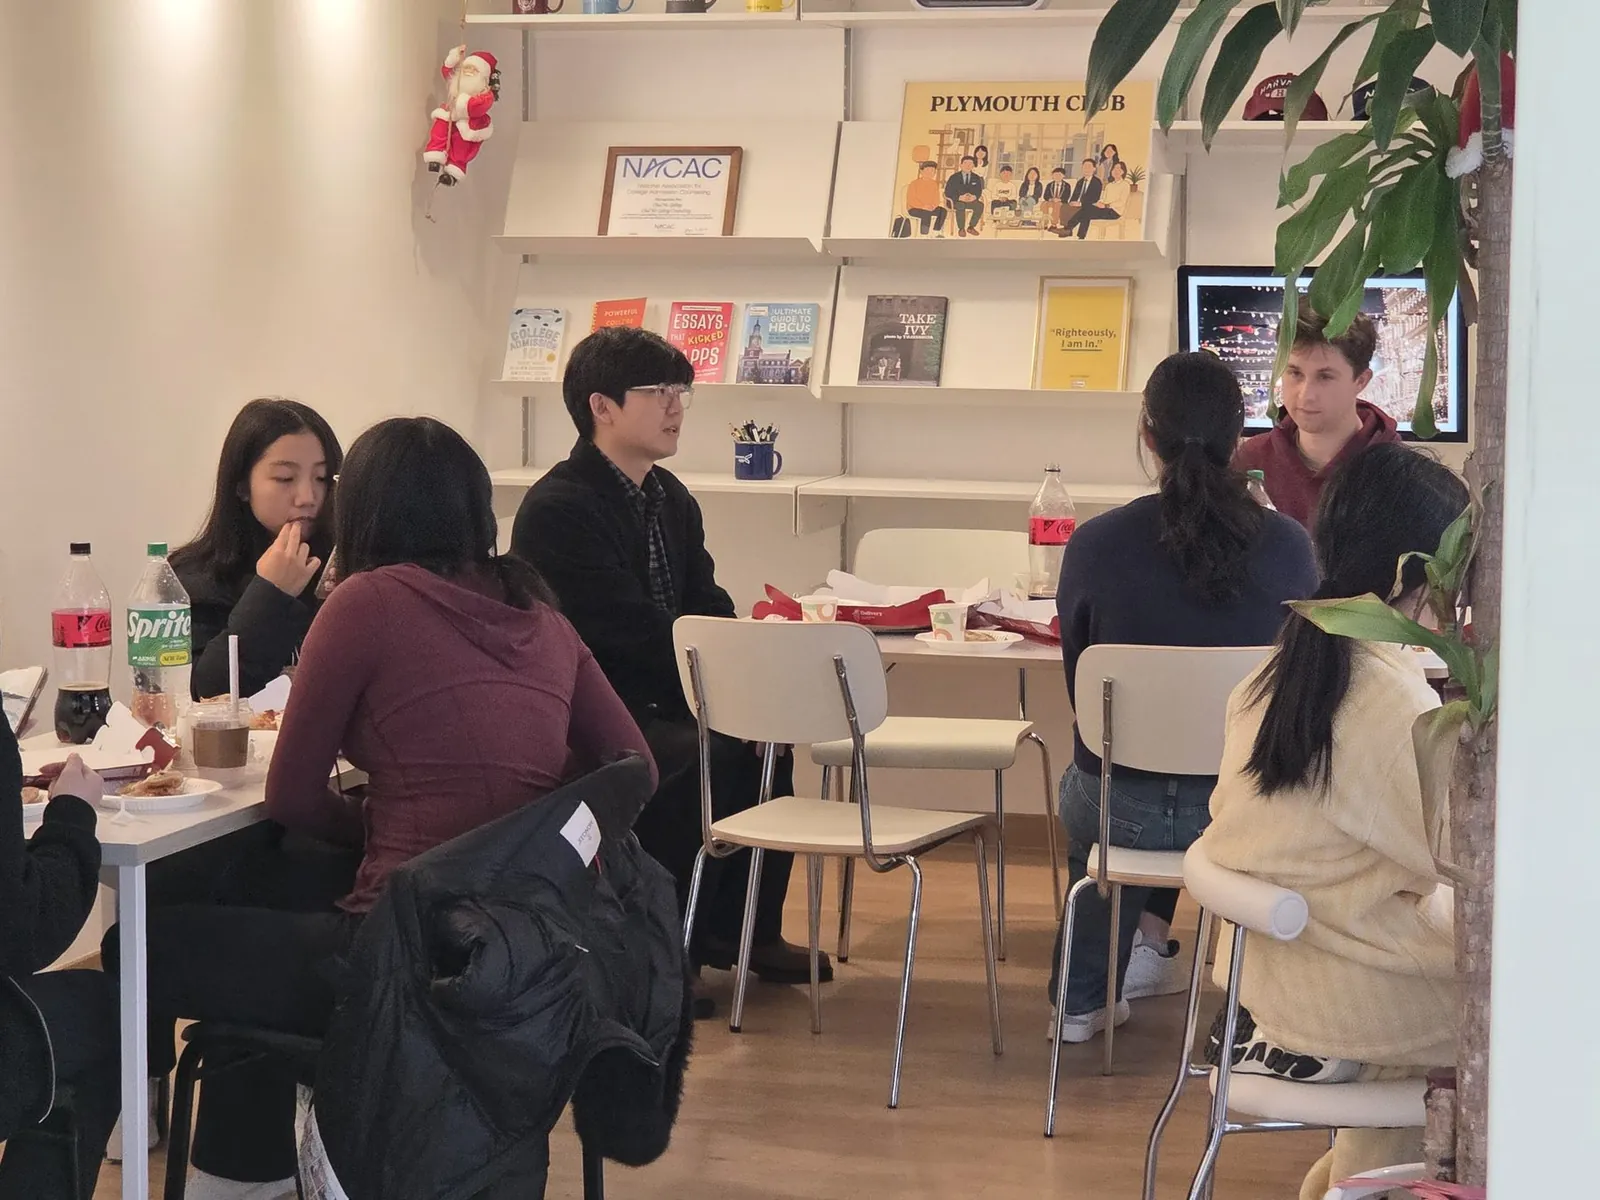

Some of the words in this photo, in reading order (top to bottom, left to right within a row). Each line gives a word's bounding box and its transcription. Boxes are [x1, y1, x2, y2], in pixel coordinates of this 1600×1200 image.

[1260, 79, 1292, 96] HARVA
[930, 95, 1060, 112] PLYMOUTH
[622, 157, 722, 178] NACAC
[673, 313, 723, 330] ESSAYS
[770, 315, 797, 323] GUIDE
[800, 315, 811, 323] TO
[899, 313, 937, 324] TAKE
[510, 327, 561, 342] COLLEGE
[688, 330, 724, 345] KICKED
[904, 325, 930, 335] IVY
[1067, 340, 1083, 348] am
[128, 610, 191, 644] Sprite
